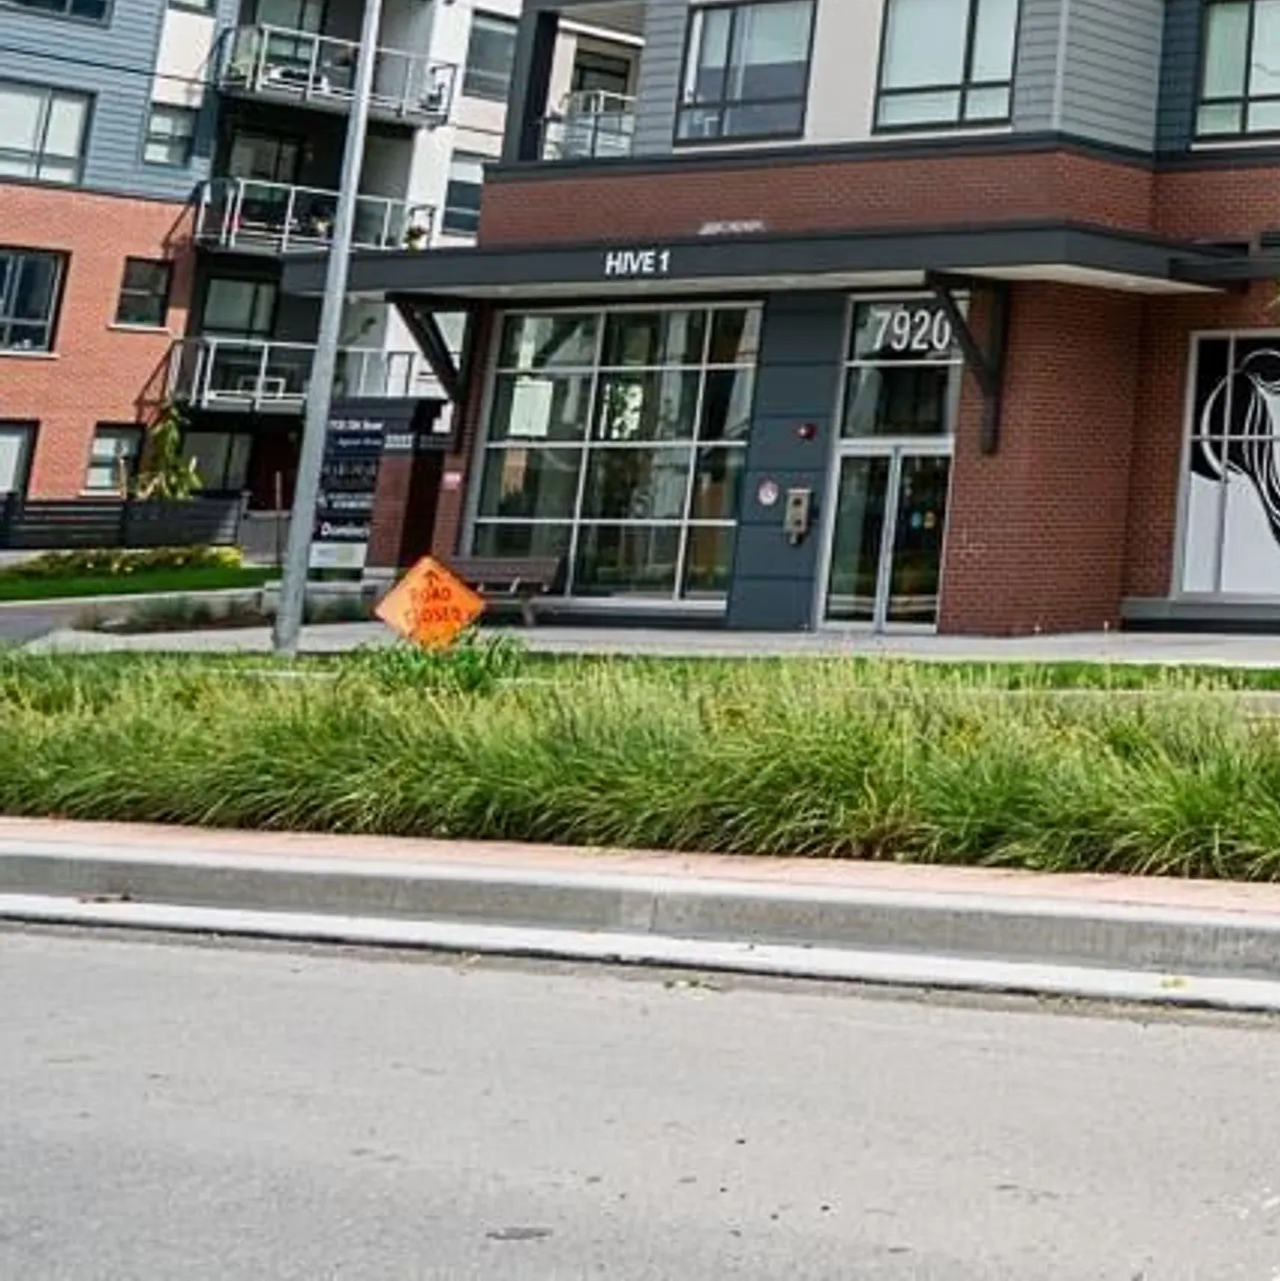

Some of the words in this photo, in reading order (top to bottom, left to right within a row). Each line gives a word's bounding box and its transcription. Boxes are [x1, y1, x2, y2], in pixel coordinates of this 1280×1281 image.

[605, 252, 655, 275] HIVE
[657, 251, 671, 272] 1
[873, 308, 950, 351] 7920
